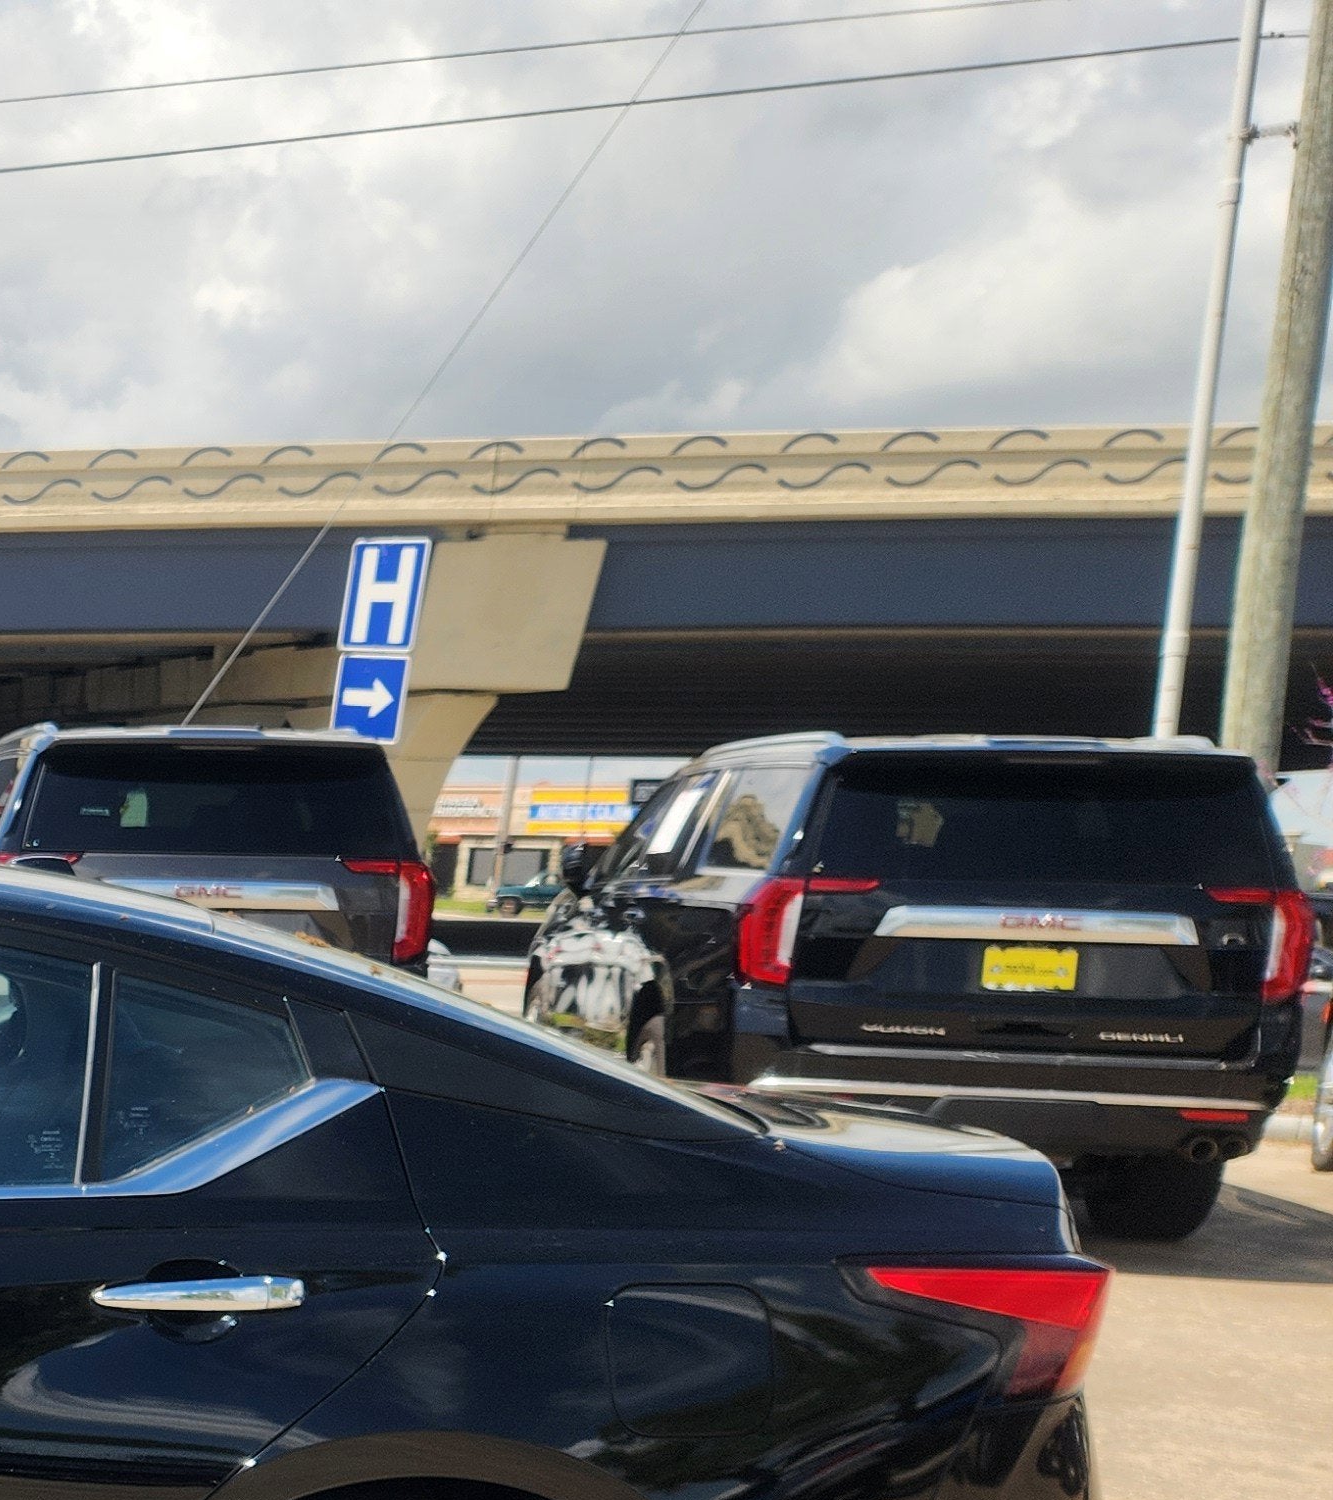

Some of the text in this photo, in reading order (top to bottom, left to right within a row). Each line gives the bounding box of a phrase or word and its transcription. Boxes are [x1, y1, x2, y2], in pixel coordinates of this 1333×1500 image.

[349, 546, 418, 645] H
[174, 883, 244, 899] GMC
[1000, 913, 1083, 932] GMC
[860, 1022, 946, 1036] YUKON
[1099, 1030, 1184, 1043] DENALI
